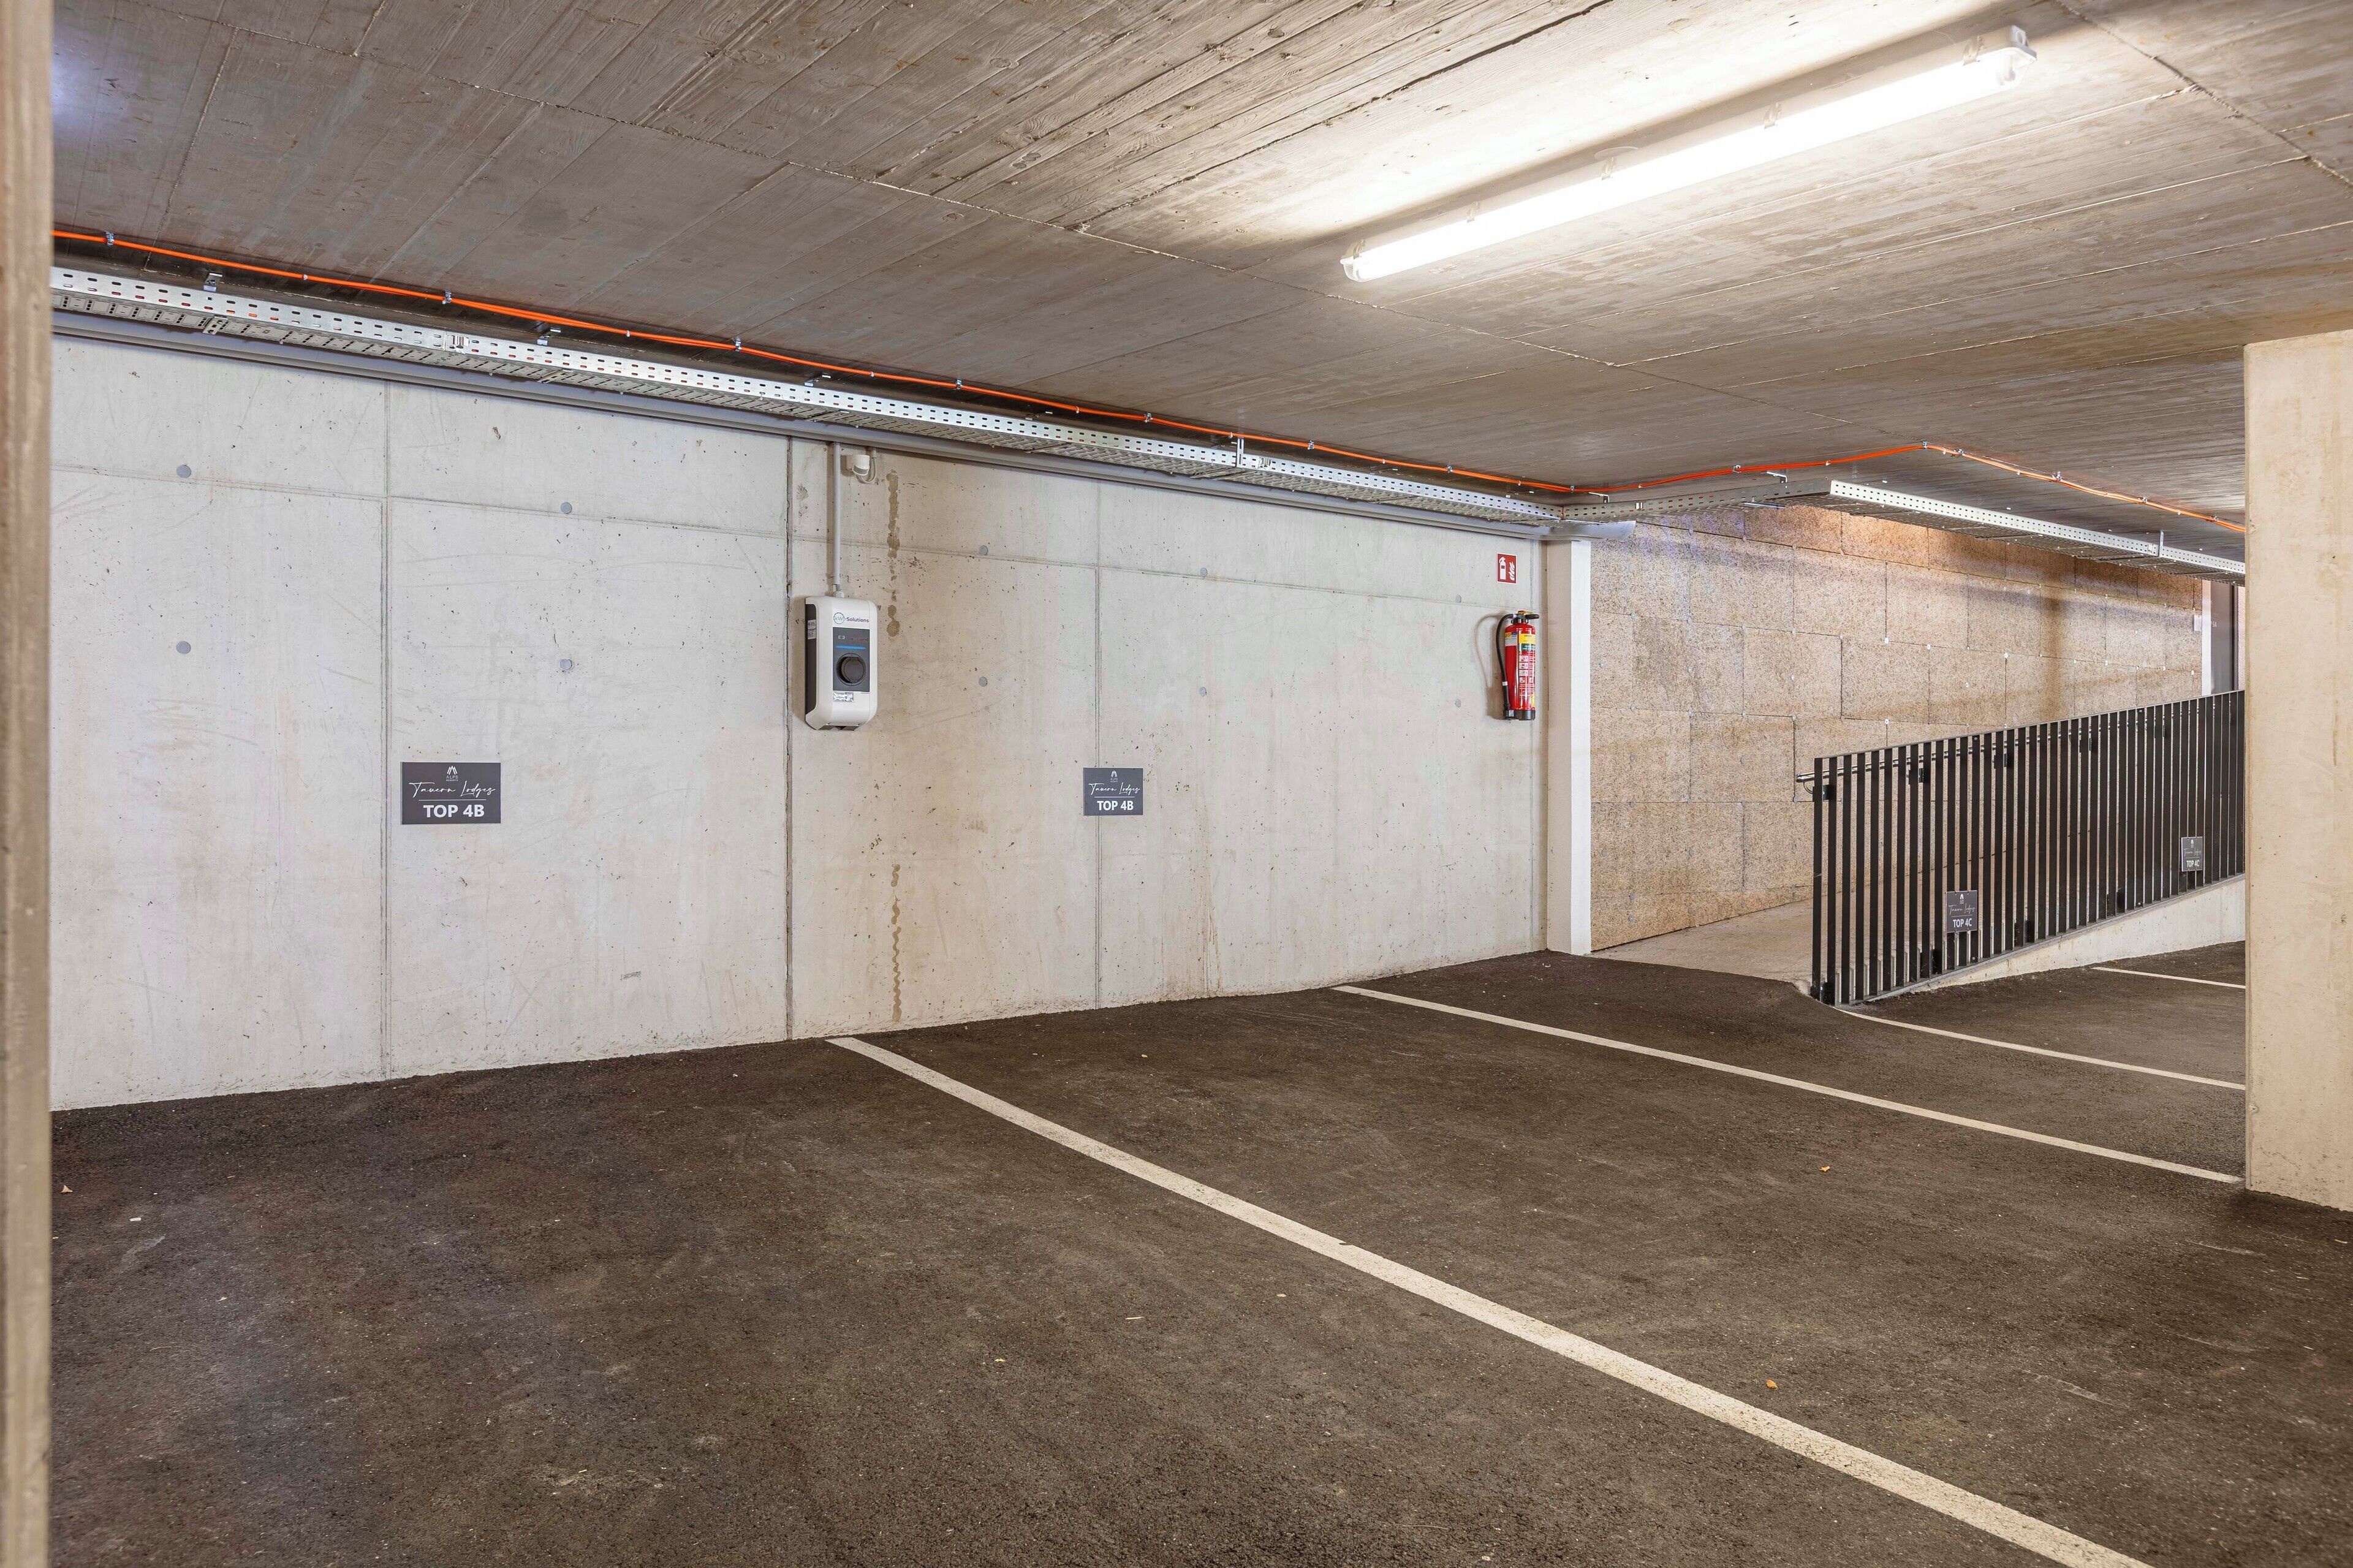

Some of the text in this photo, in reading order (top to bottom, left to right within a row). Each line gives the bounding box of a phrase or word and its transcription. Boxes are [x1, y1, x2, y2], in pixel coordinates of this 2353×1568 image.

[460, 780, 496, 798] Lodges
[1119, 782, 1140, 795] Lodges
[423, 804, 485, 818] TOP 4B
[1097, 800, 1134, 811] TOP 4B
[1953, 918, 1972, 928] TOP 4C
